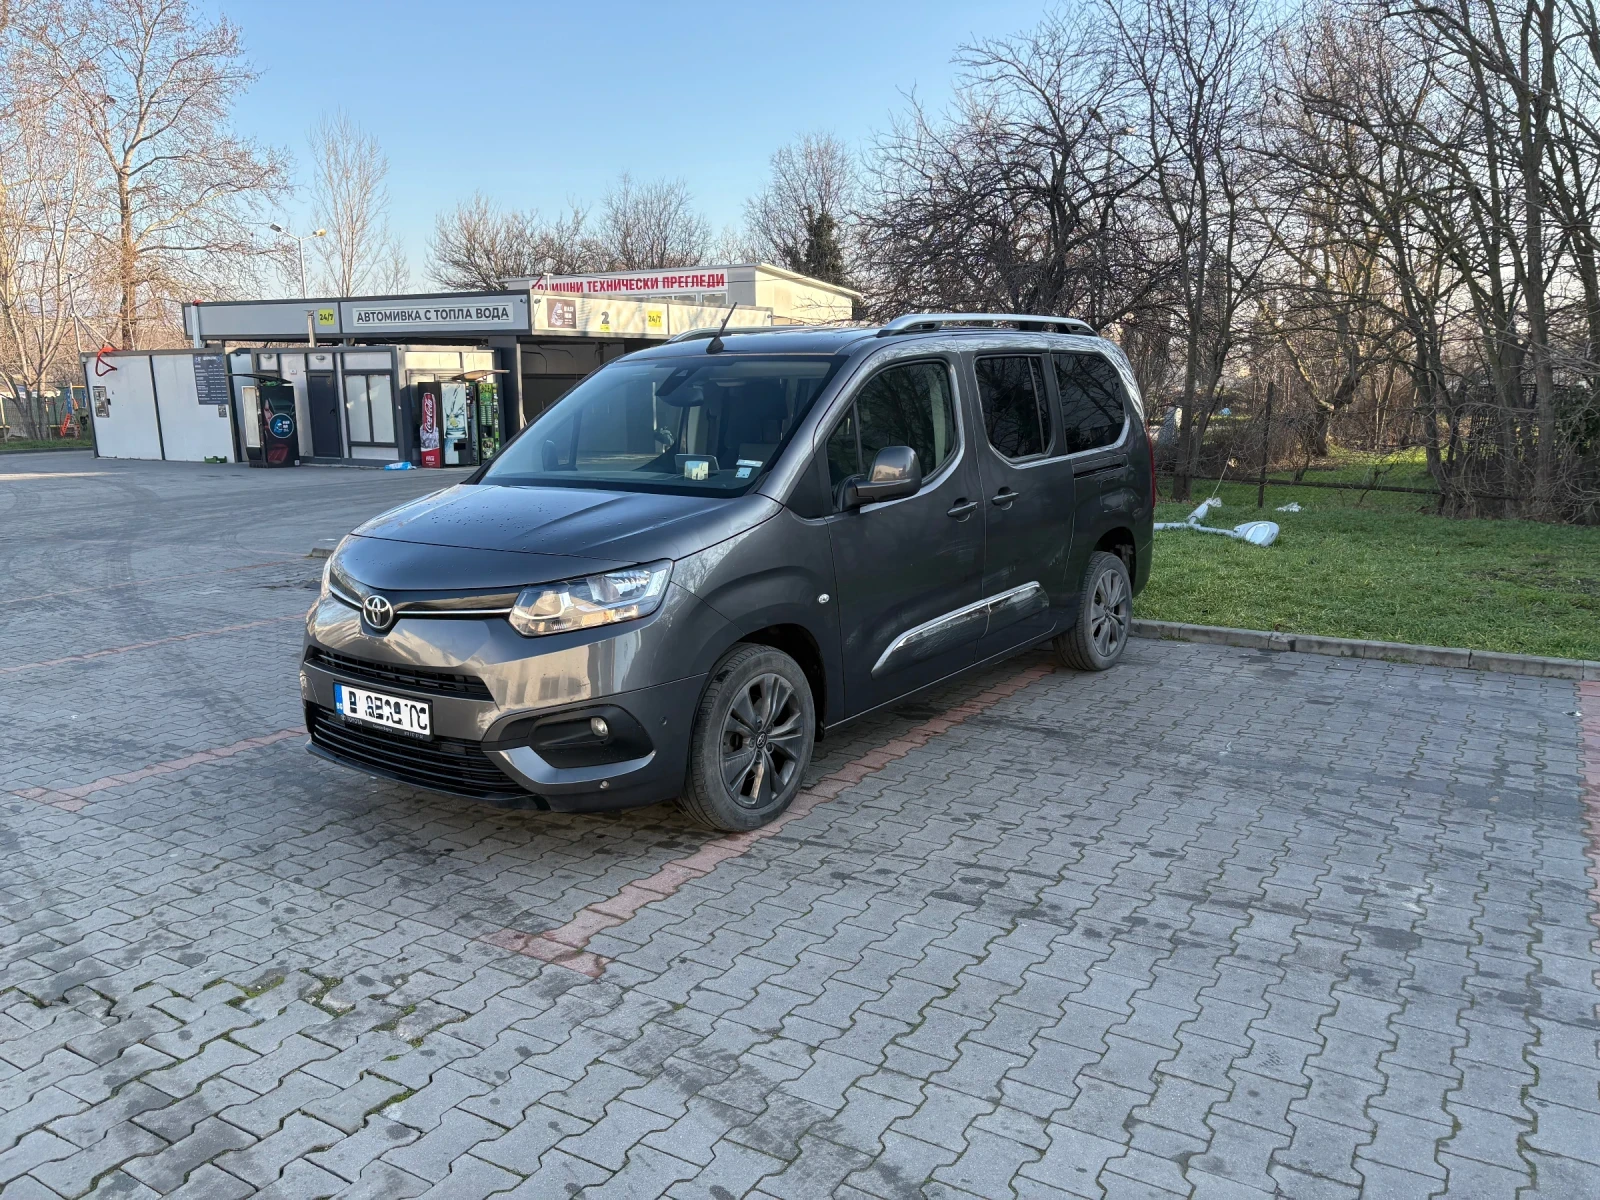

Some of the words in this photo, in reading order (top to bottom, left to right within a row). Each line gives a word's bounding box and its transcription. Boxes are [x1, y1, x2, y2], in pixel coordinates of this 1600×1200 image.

[586, 276, 659, 293] ТЕХНИЧЕСКИ
[662, 273, 725, 289] ПРЕГЛЕДИ
[319, 312, 334, 321] 24/7
[356, 309, 422, 323] АВТОМИВКА
[424, 309, 432, 321] С
[433, 307, 473, 320] ТОПЛА
[475, 306, 509, 321] ВОДА
[601, 311, 610, 325] 2
[648, 315, 662, 323] 24/7
